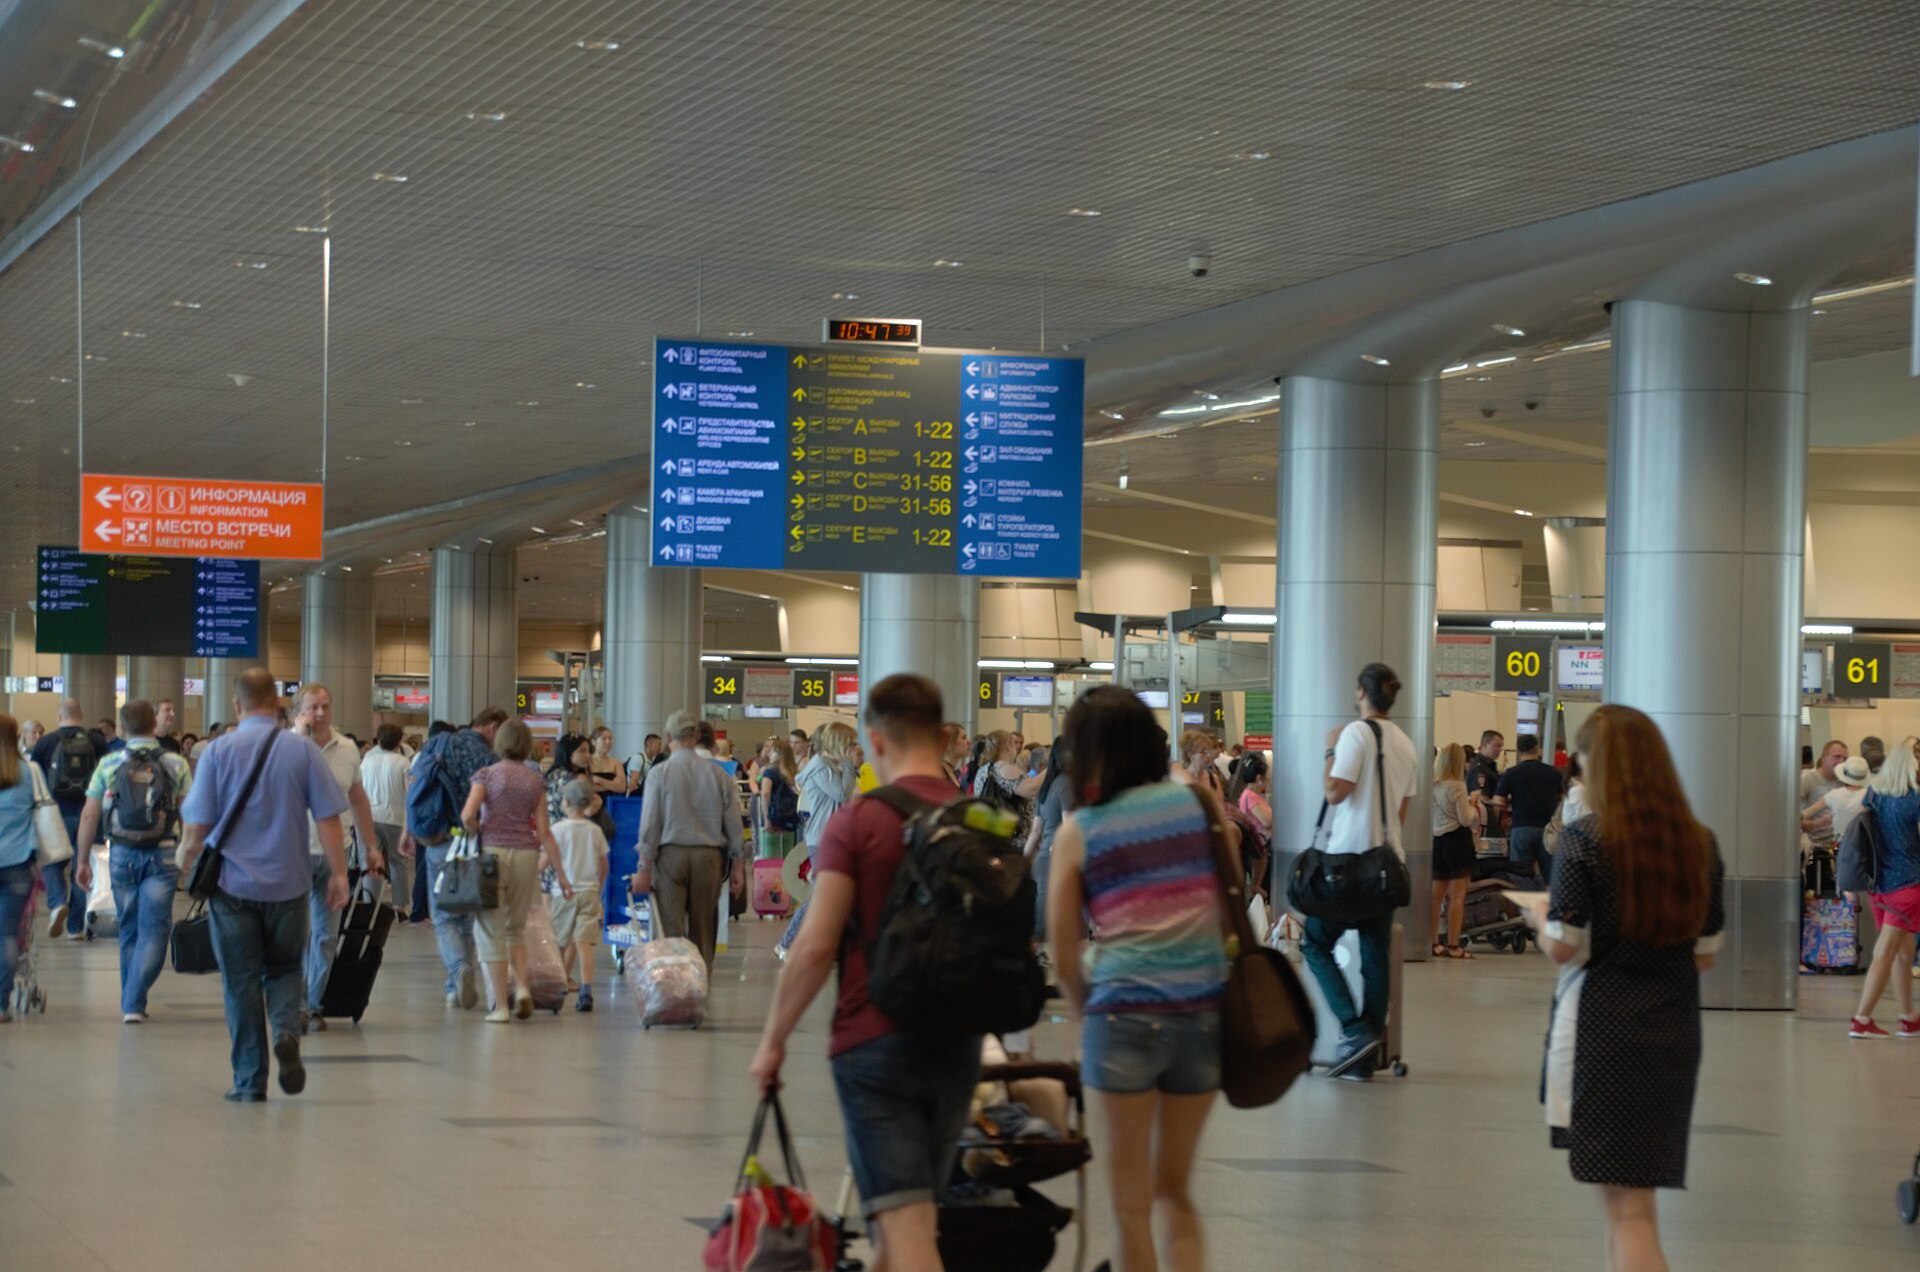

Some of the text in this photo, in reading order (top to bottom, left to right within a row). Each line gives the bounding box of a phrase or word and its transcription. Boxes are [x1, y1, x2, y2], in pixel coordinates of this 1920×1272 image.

[839, 321, 890, 340] 10:47
[914, 421, 953, 439] 1-22
[697, 459, 726, 469] АРЕНДА
[913, 450, 953, 469] 1-22
[853, 471, 867, 489] C
[900, 473, 952, 492] 31-56
[190, 487, 306, 507] ИНФОРМАЦИЯ
[697, 487, 764, 498] КАМЕРА ХРАНЕНИЯ
[190, 505, 268, 518] INFORMATION
[853, 495, 867, 512] D
[900, 497, 951, 516] 31-56
[156, 519, 291, 538] МЕСТО ВСТРЕЧИ
[696, 516, 731, 525] ДУШЕВАЯ
[156, 537, 246, 550] MEETING POINT
[912, 528, 951, 546] 1-22
[696, 544, 722, 553] ТУАЛЕТ
[1014, 543, 1040, 551] ТУАЛЕТ
[1506, 651, 1540, 677] 60
[1571, 661, 1589, 669] NN
[1847, 657, 1878, 684] 61
[713, 677, 736, 695] 34
[801, 679, 824, 697] 35
